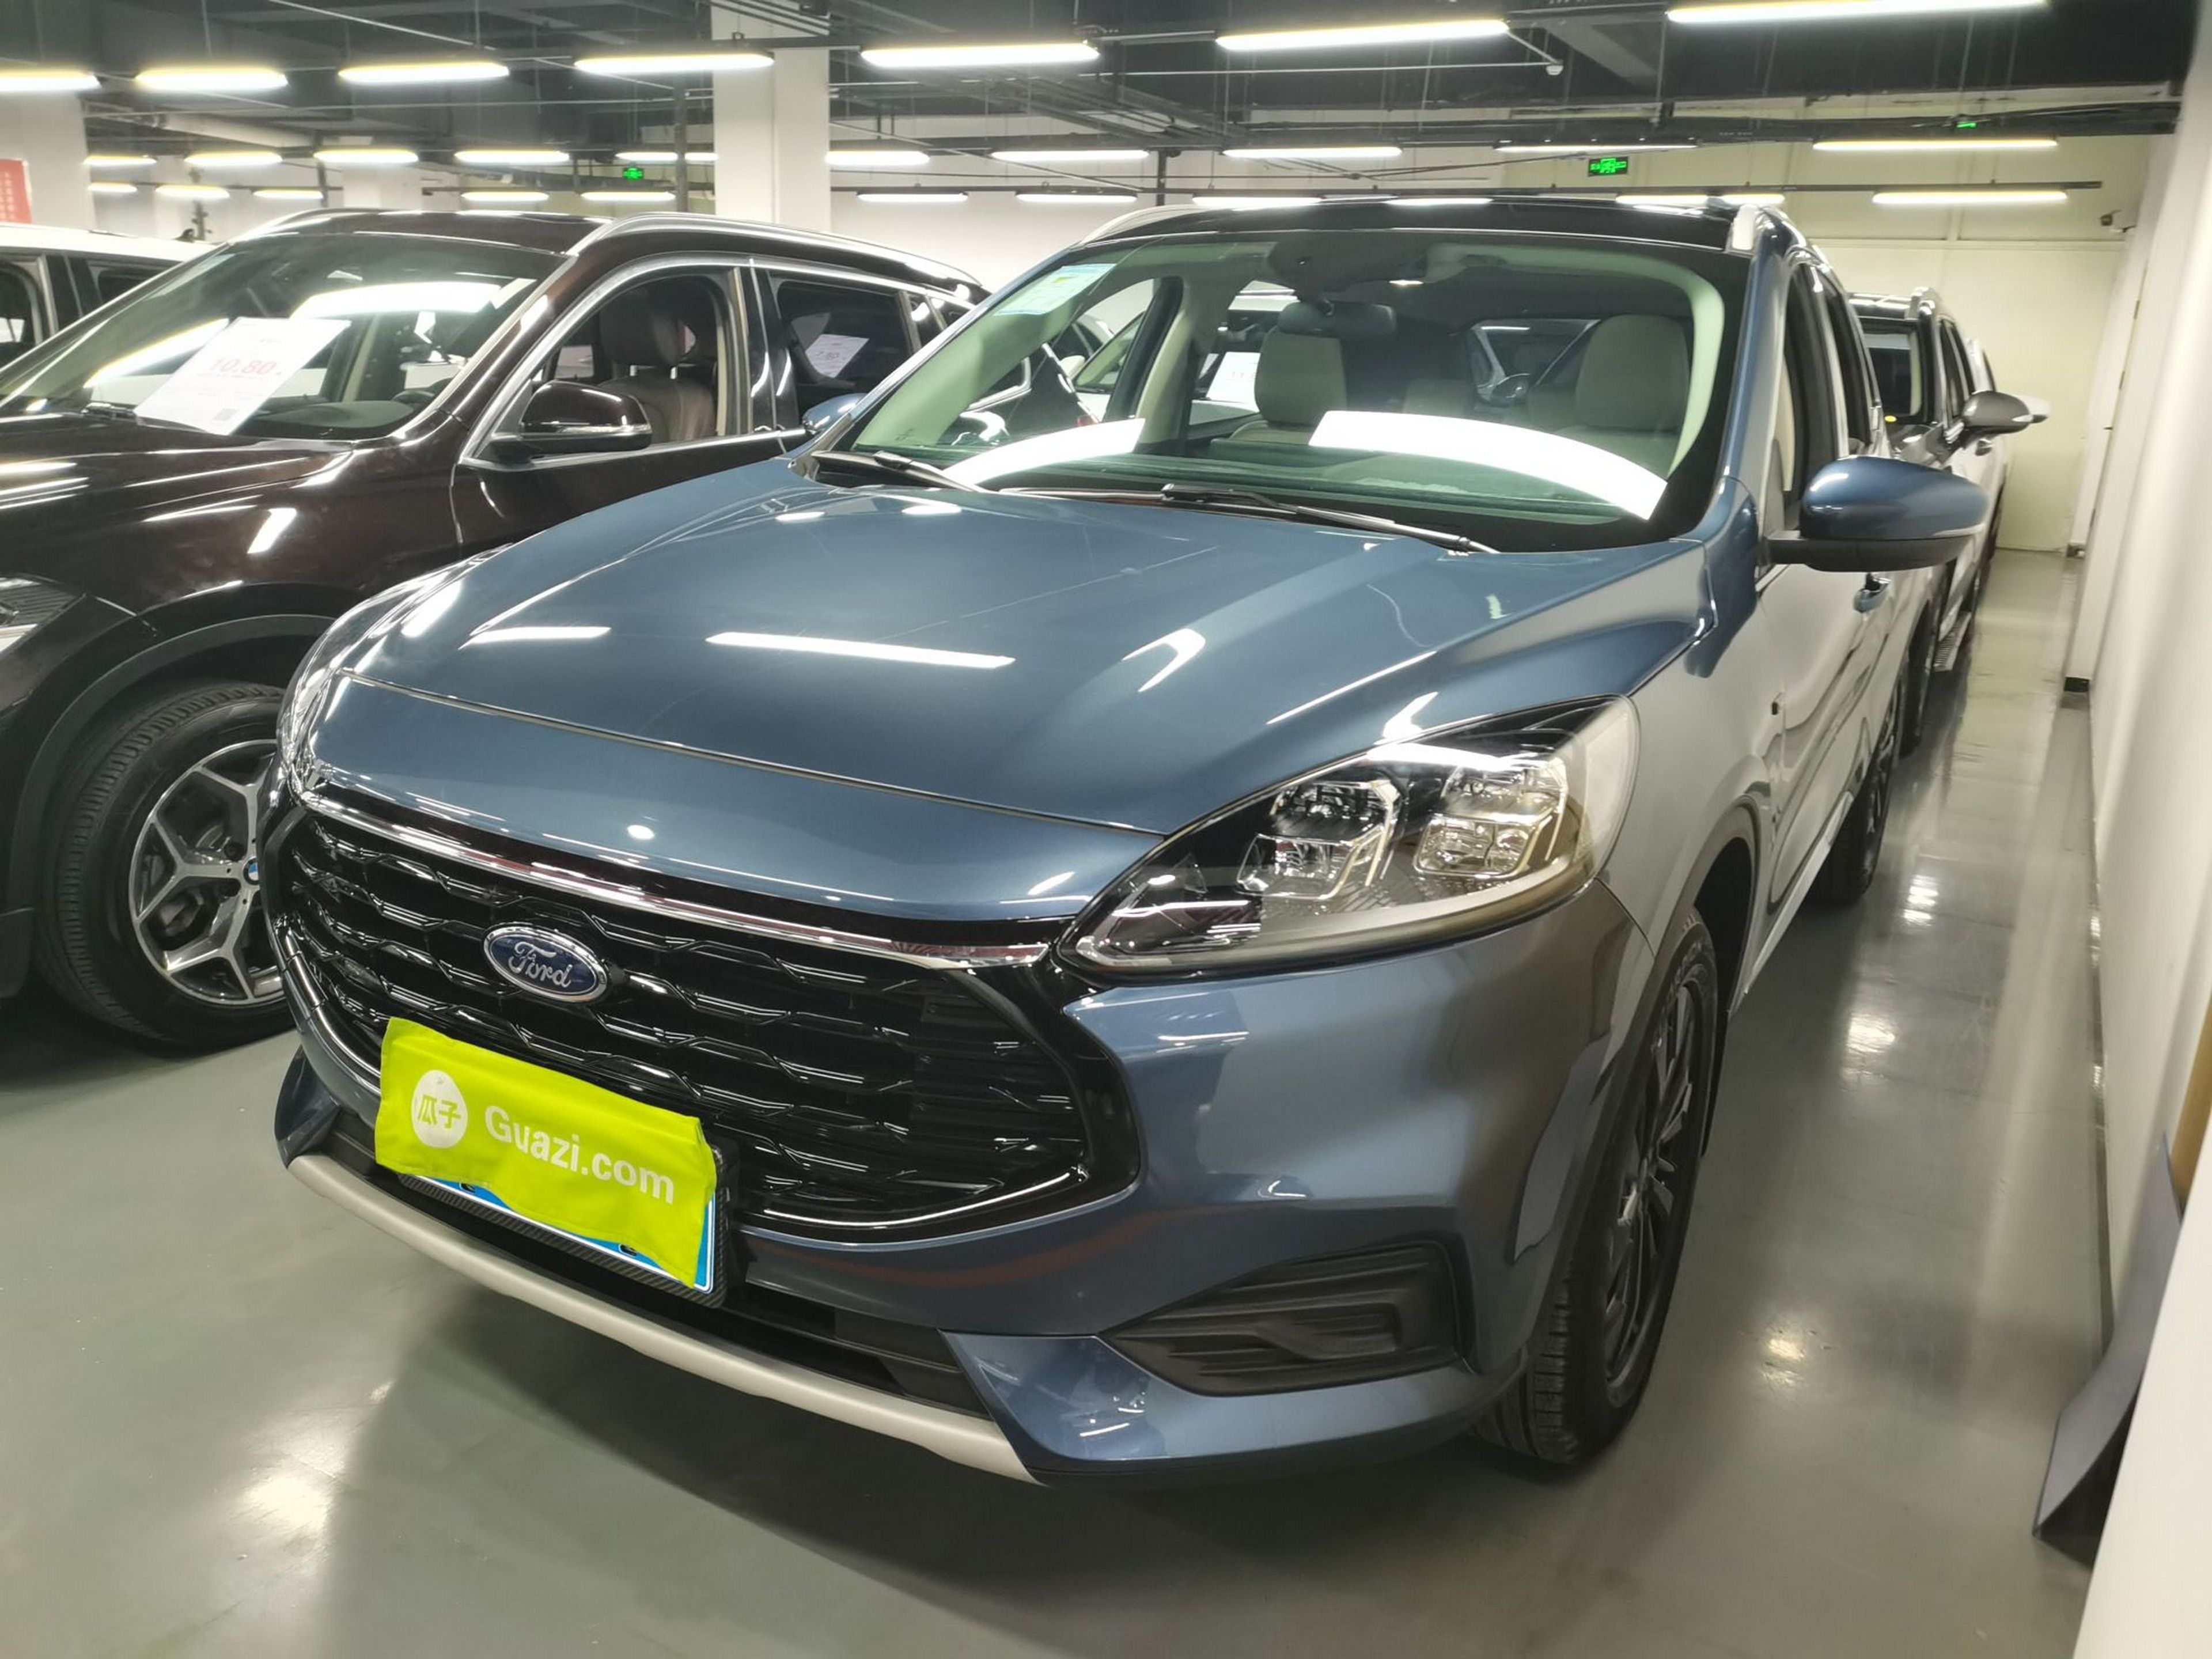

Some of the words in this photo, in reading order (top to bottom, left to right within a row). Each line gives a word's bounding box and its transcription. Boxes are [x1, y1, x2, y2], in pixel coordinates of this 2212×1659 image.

[210, 358, 278, 375] 10.80
[508, 941, 573, 988] Ford
[417, 1094, 461, 1129] 瓜子
[484, 1105, 674, 1205] Guazi.com
